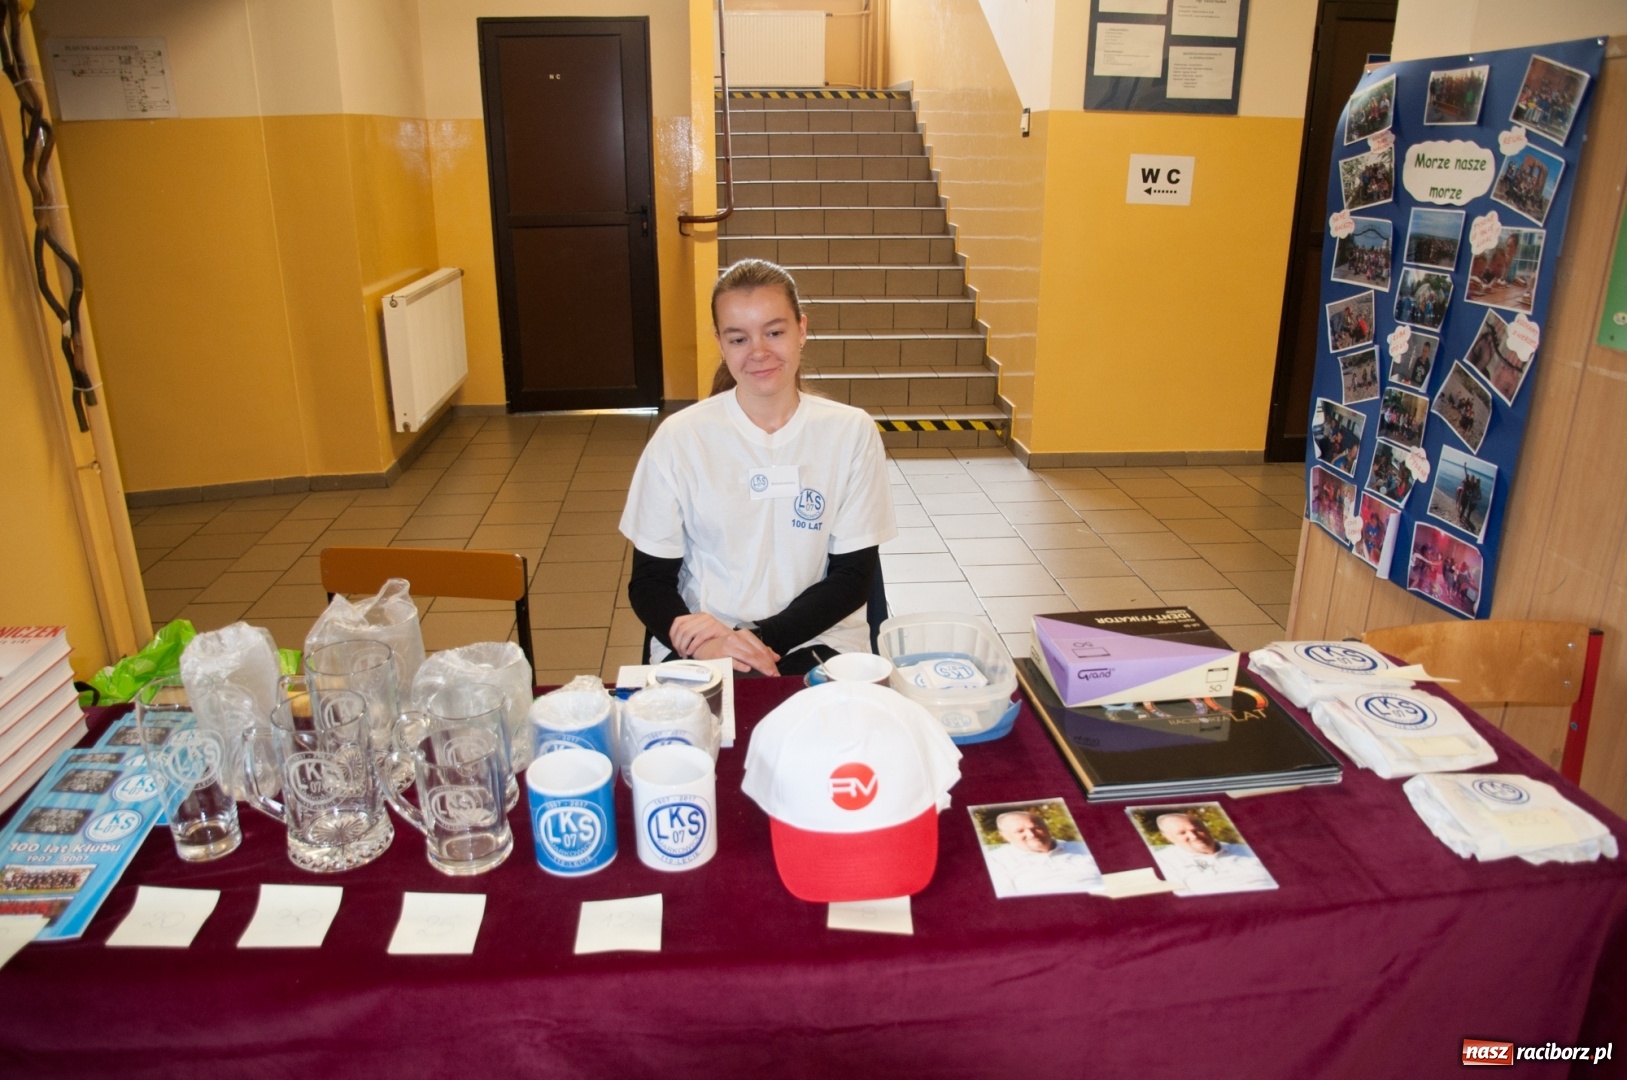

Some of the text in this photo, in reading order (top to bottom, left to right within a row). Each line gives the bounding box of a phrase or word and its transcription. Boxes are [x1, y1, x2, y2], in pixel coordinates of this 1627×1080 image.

[1414, 153, 1487, 171] Morze nasze
[1429, 185, 1463, 200] morze
[798, 490, 822, 511] LKS
[791, 518, 823, 531] 100 LAT
[1308, 646, 1367, 664] LKS
[1077, 668, 1112, 681] Grand
[1209, 684, 1222, 693] 50
[1370, 698, 1418, 715] LKS
[1230, 708, 1269, 722] LAT
[93, 812, 136, 831] LKS
[547, 811, 595, 843] LKS
[655, 807, 701, 839] LKS
[102, 825, 120, 834] 07
[672, 830, 686, 843] 07
[9, 842, 121, 853] 100 lat Klubu
[563, 834, 577, 848] 07
[27, 855, 52, 863] 1907
[61, 855, 90, 863] 2007
[142, 910, 186, 930] 20
[275, 907, 323, 930] 30
